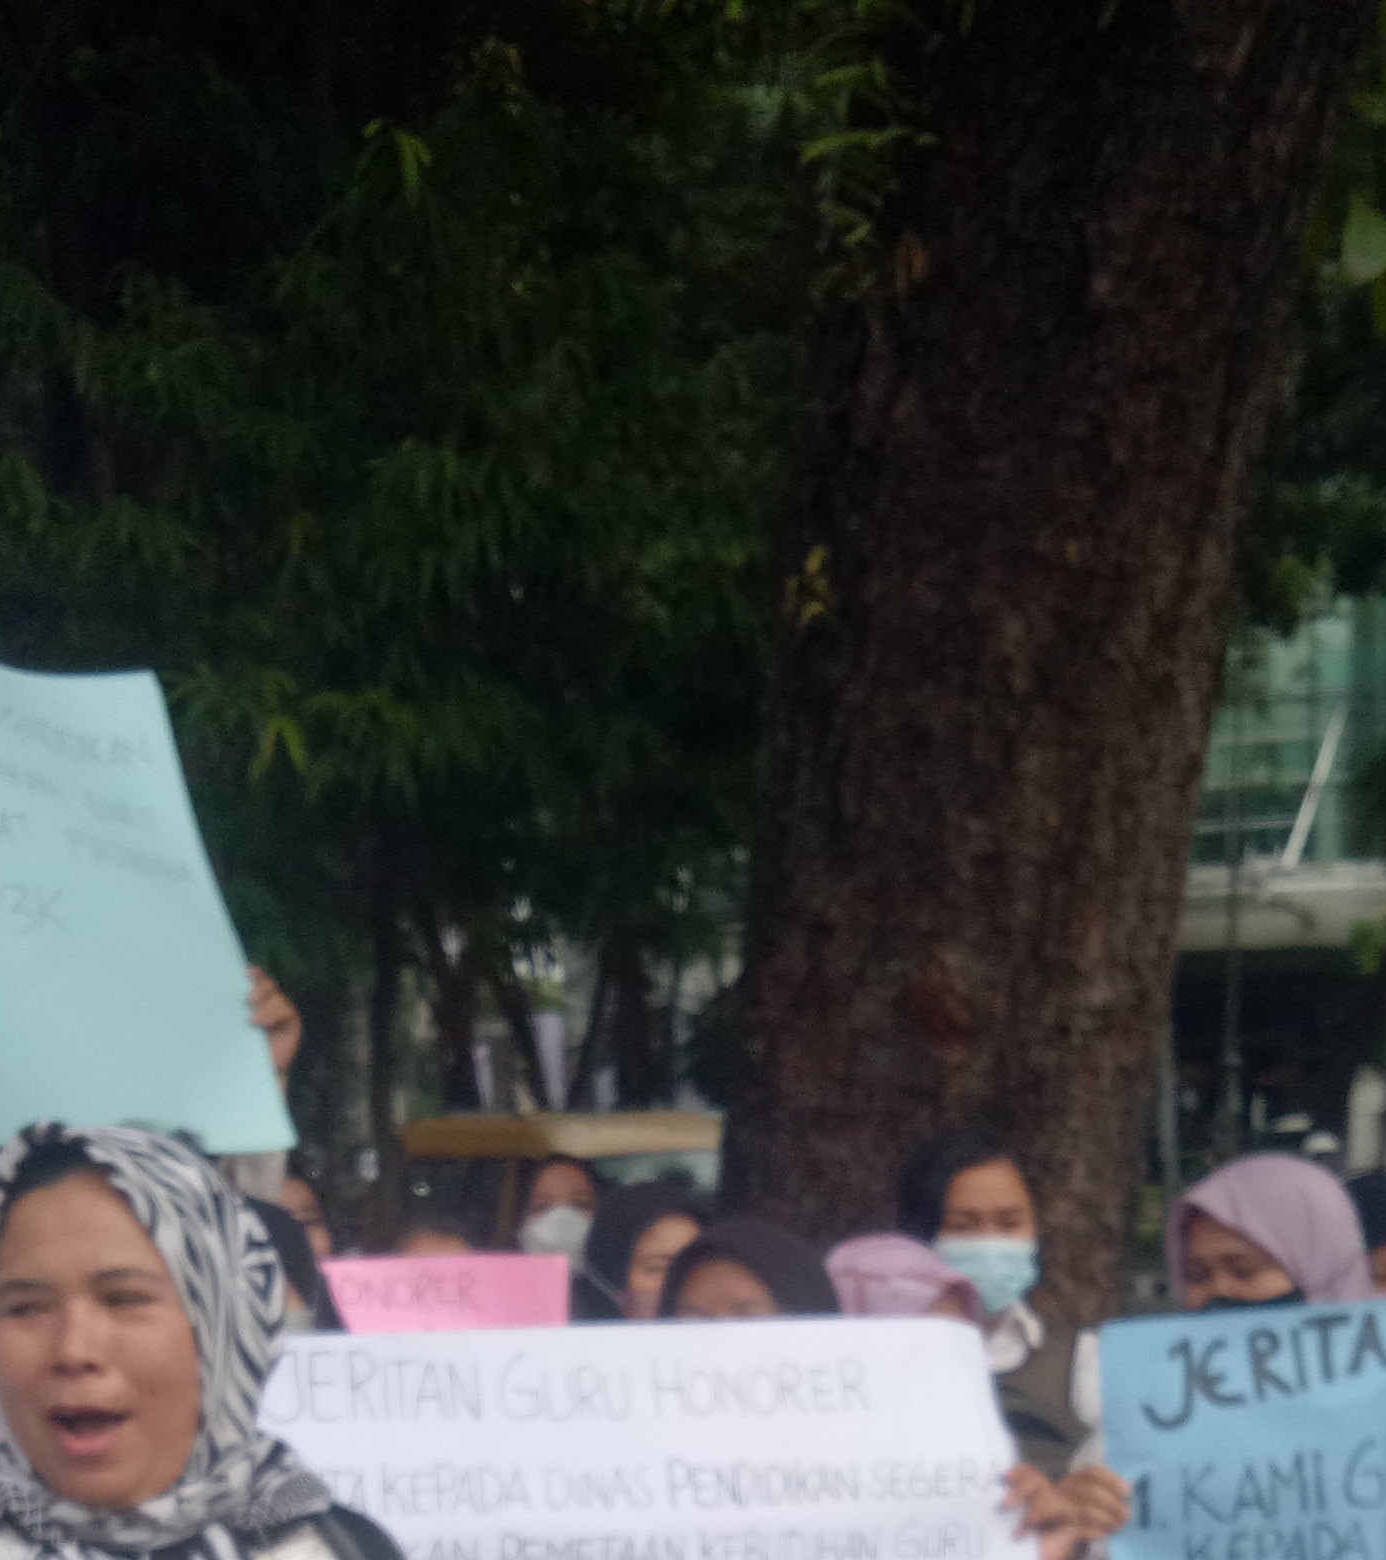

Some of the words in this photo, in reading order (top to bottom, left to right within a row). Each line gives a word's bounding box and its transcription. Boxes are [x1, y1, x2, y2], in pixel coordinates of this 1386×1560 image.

[340, 1268, 483, 1312] ONORER
[499, 1351, 632, 1422] GURU
[649, 1357, 871, 1419] HONORER
[381, 1462, 533, 1516] KEPADA
[545, 1463, 654, 1511] DINAS
[666, 1457, 861, 1511] PENDIDIKAN
[1182, 1450, 1328, 1526] KAMI
